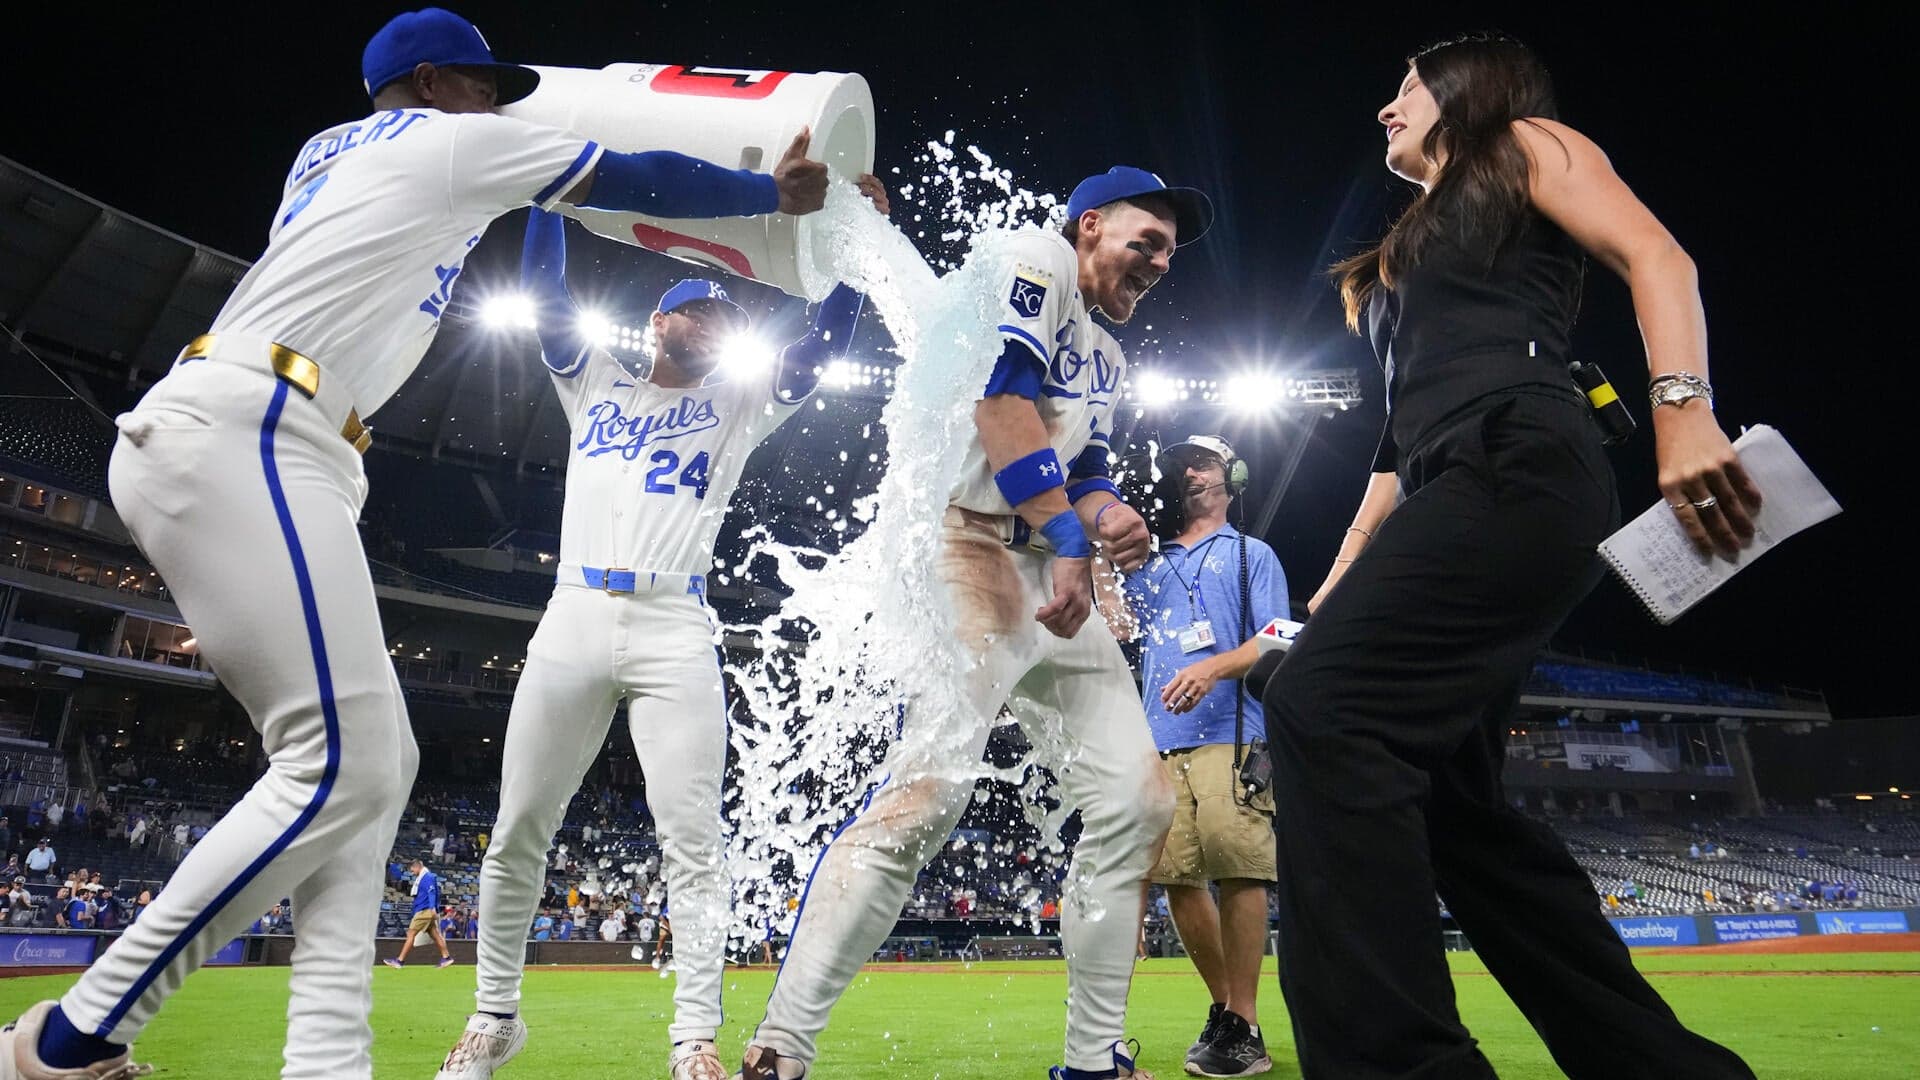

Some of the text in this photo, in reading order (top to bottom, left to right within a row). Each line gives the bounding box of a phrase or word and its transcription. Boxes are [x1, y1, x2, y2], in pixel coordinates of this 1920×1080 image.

[1012, 281, 1041, 313] KC
[577, 396, 719, 461] Royals
[645, 450, 709, 500] 24
[1205, 556, 1224, 574] KC
